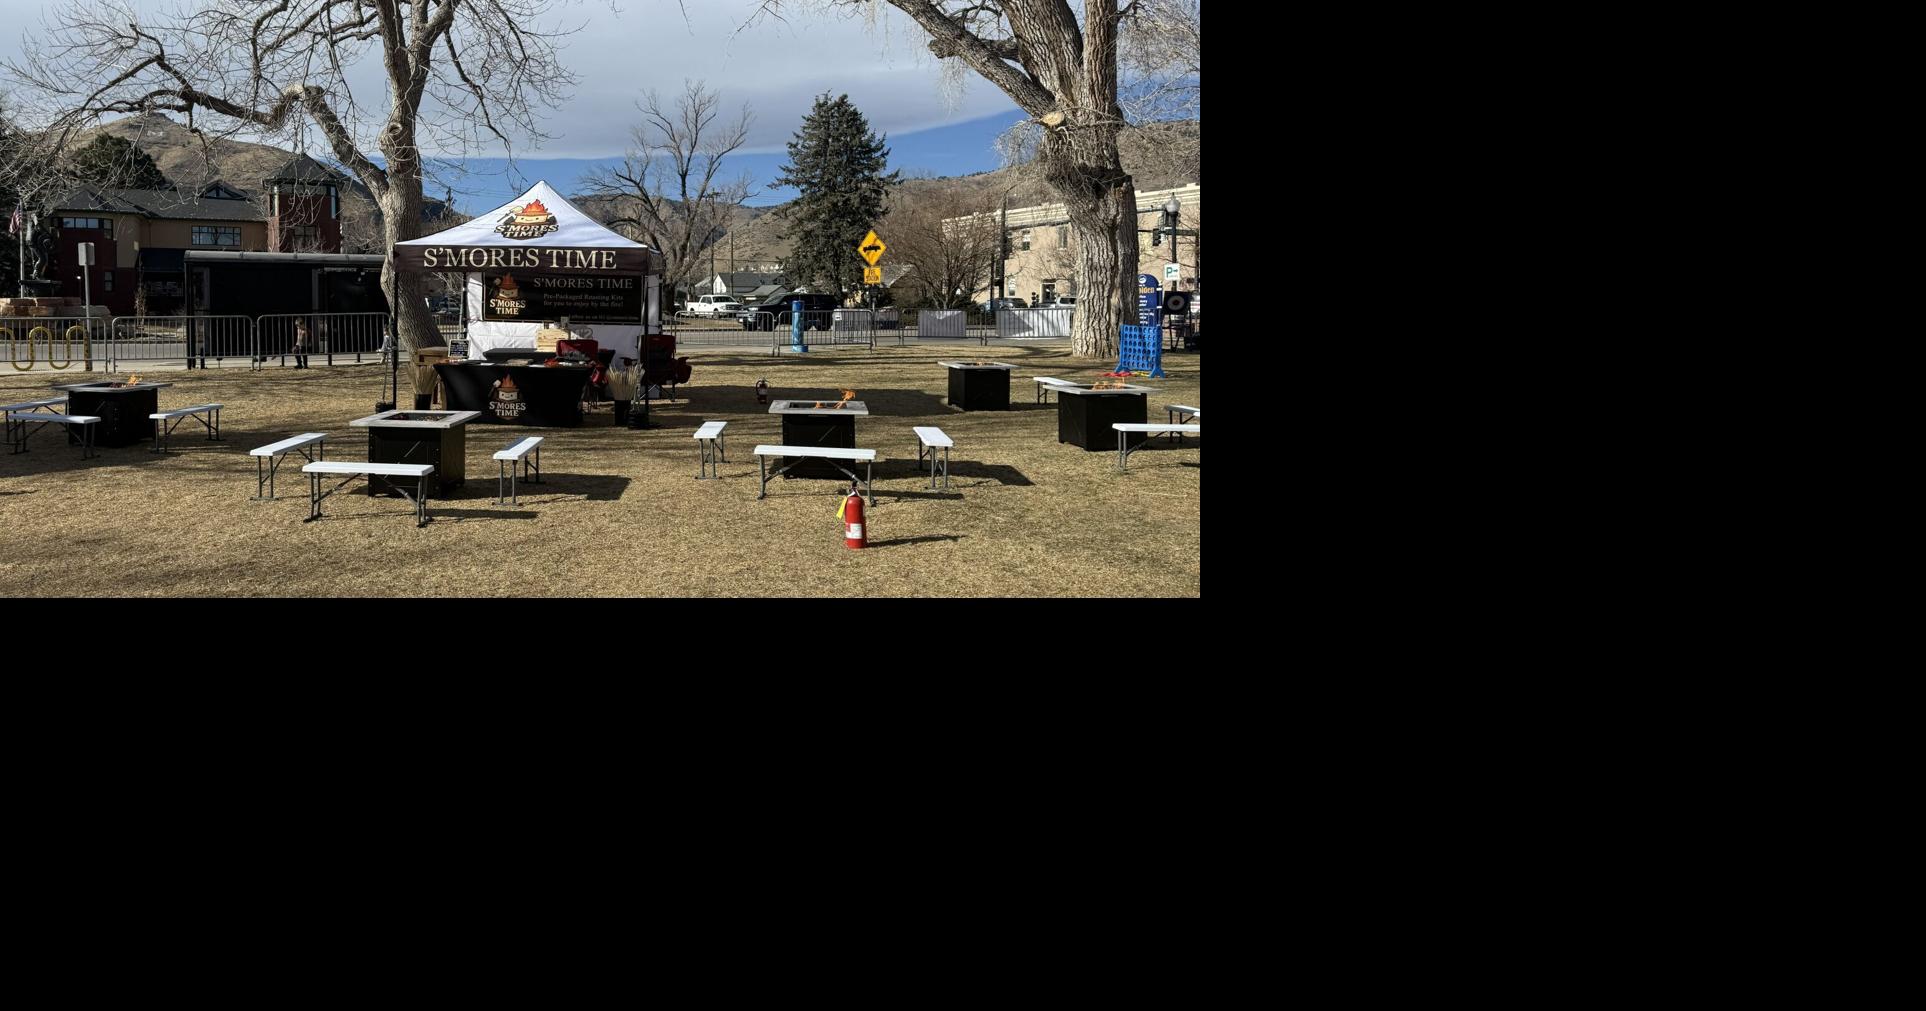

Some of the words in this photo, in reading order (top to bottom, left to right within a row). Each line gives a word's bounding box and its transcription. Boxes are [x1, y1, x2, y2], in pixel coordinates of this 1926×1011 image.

[495, 224, 559, 232] S'MORES
[423, 247, 540, 267] S'MORES
[545, 249, 617, 269] TIME
[1166, 266, 1173, 278] P
[533, 277, 593, 288] S'MORES
[599, 278, 633, 289] TIME
[489, 299, 526, 308] S'MORES
[495, 307, 520, 315] TIME
[489, 401, 527, 411] S'MORES
[495, 409, 519, 417] TIME
